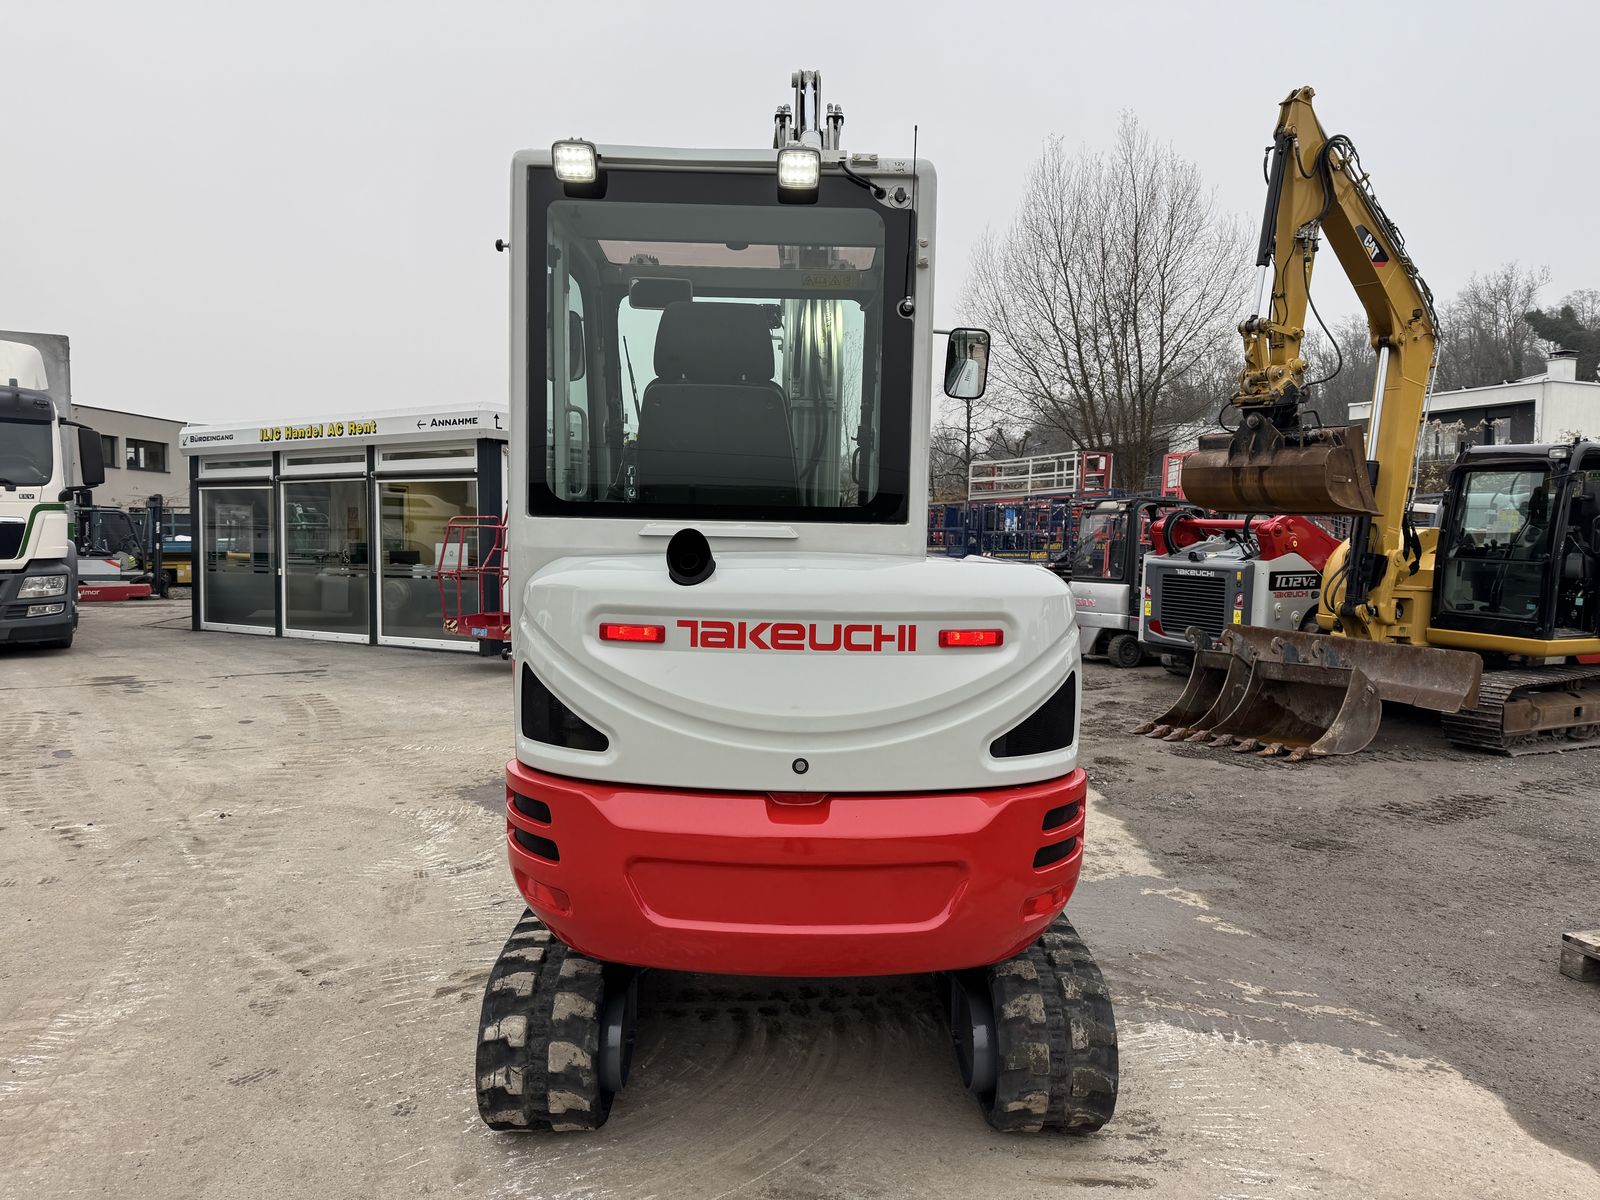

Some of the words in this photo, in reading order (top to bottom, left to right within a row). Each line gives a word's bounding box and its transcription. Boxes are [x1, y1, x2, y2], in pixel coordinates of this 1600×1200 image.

[1363, 233, 1380, 259] CAT
[285, 424, 323, 440] Handel
[347, 419, 377, 435] Rent
[430, 417, 478, 427] ANNAHME
[1176, 568, 1215, 577] TAKEUCHI
[676, 620, 916, 652] TAKEUCHI
